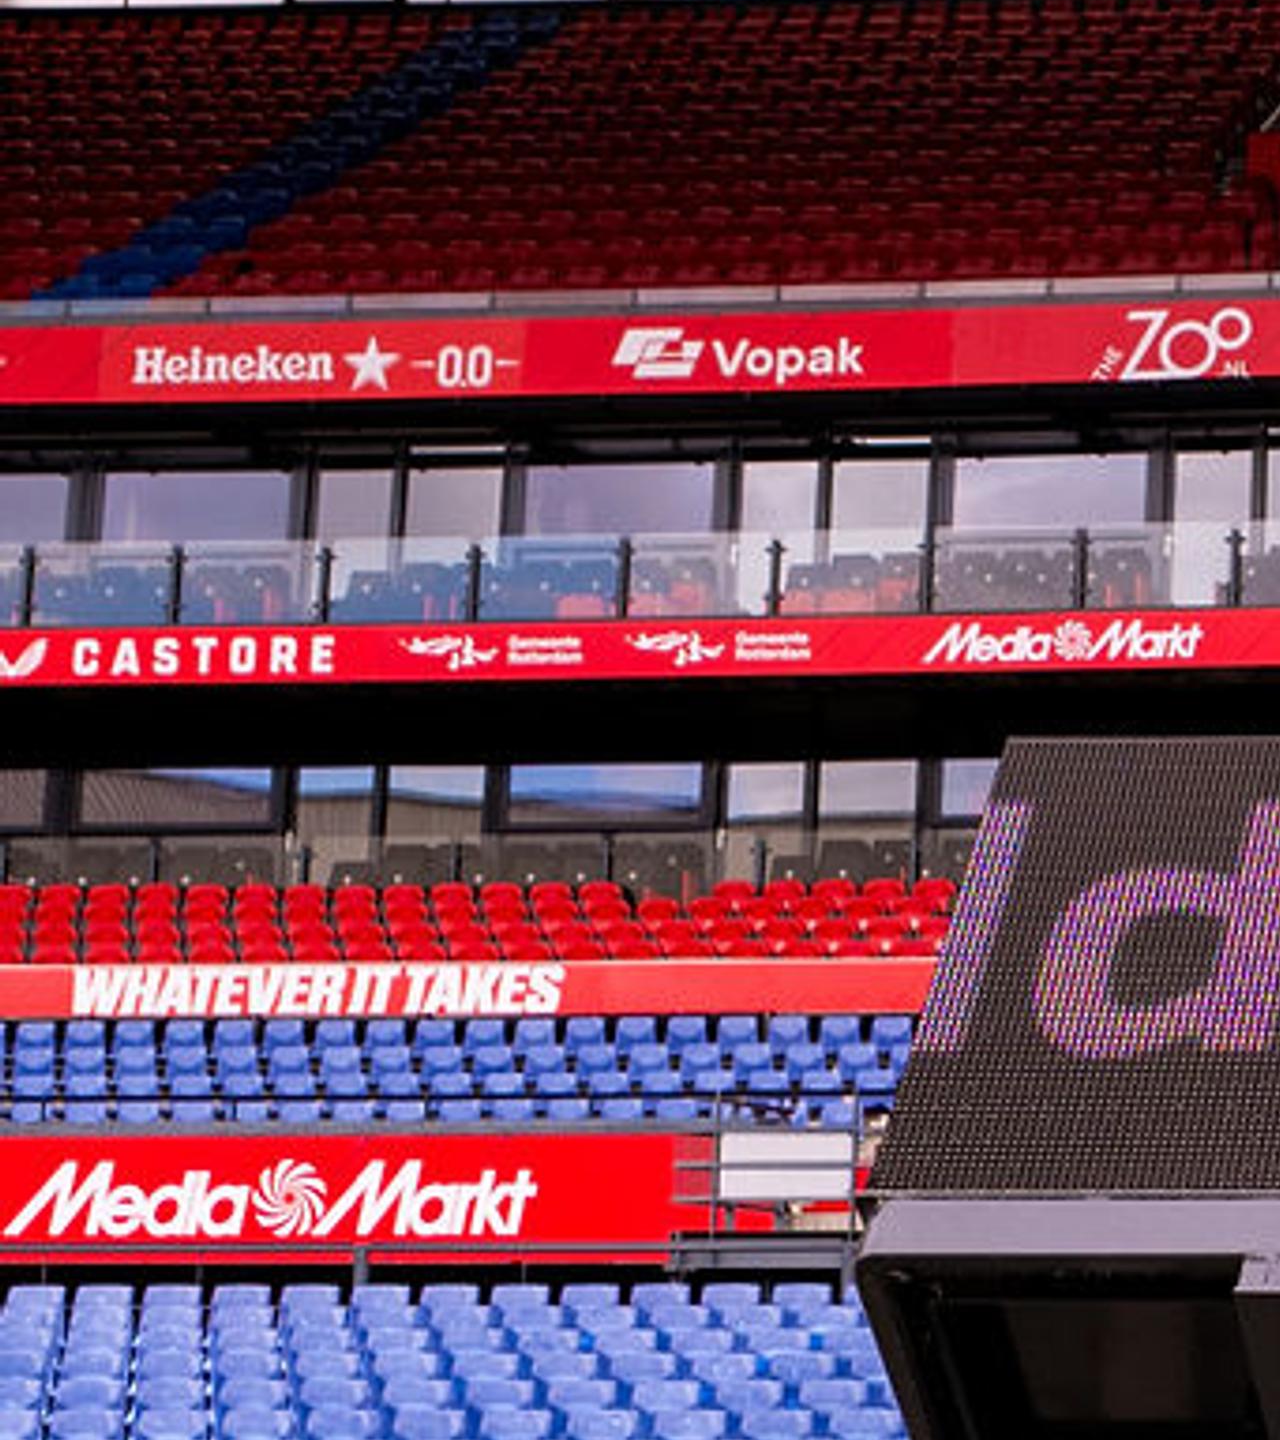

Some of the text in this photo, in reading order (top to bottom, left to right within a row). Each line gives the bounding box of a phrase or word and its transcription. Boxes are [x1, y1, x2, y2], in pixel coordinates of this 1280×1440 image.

[132, 345, 334, 384] Heineken
[713, 338, 863, 384] Vopak
[72, 635, 335, 677] CASTORE
[71, 963, 350, 1016] WHATEVER
[404, 963, 566, 1016] TAKES
